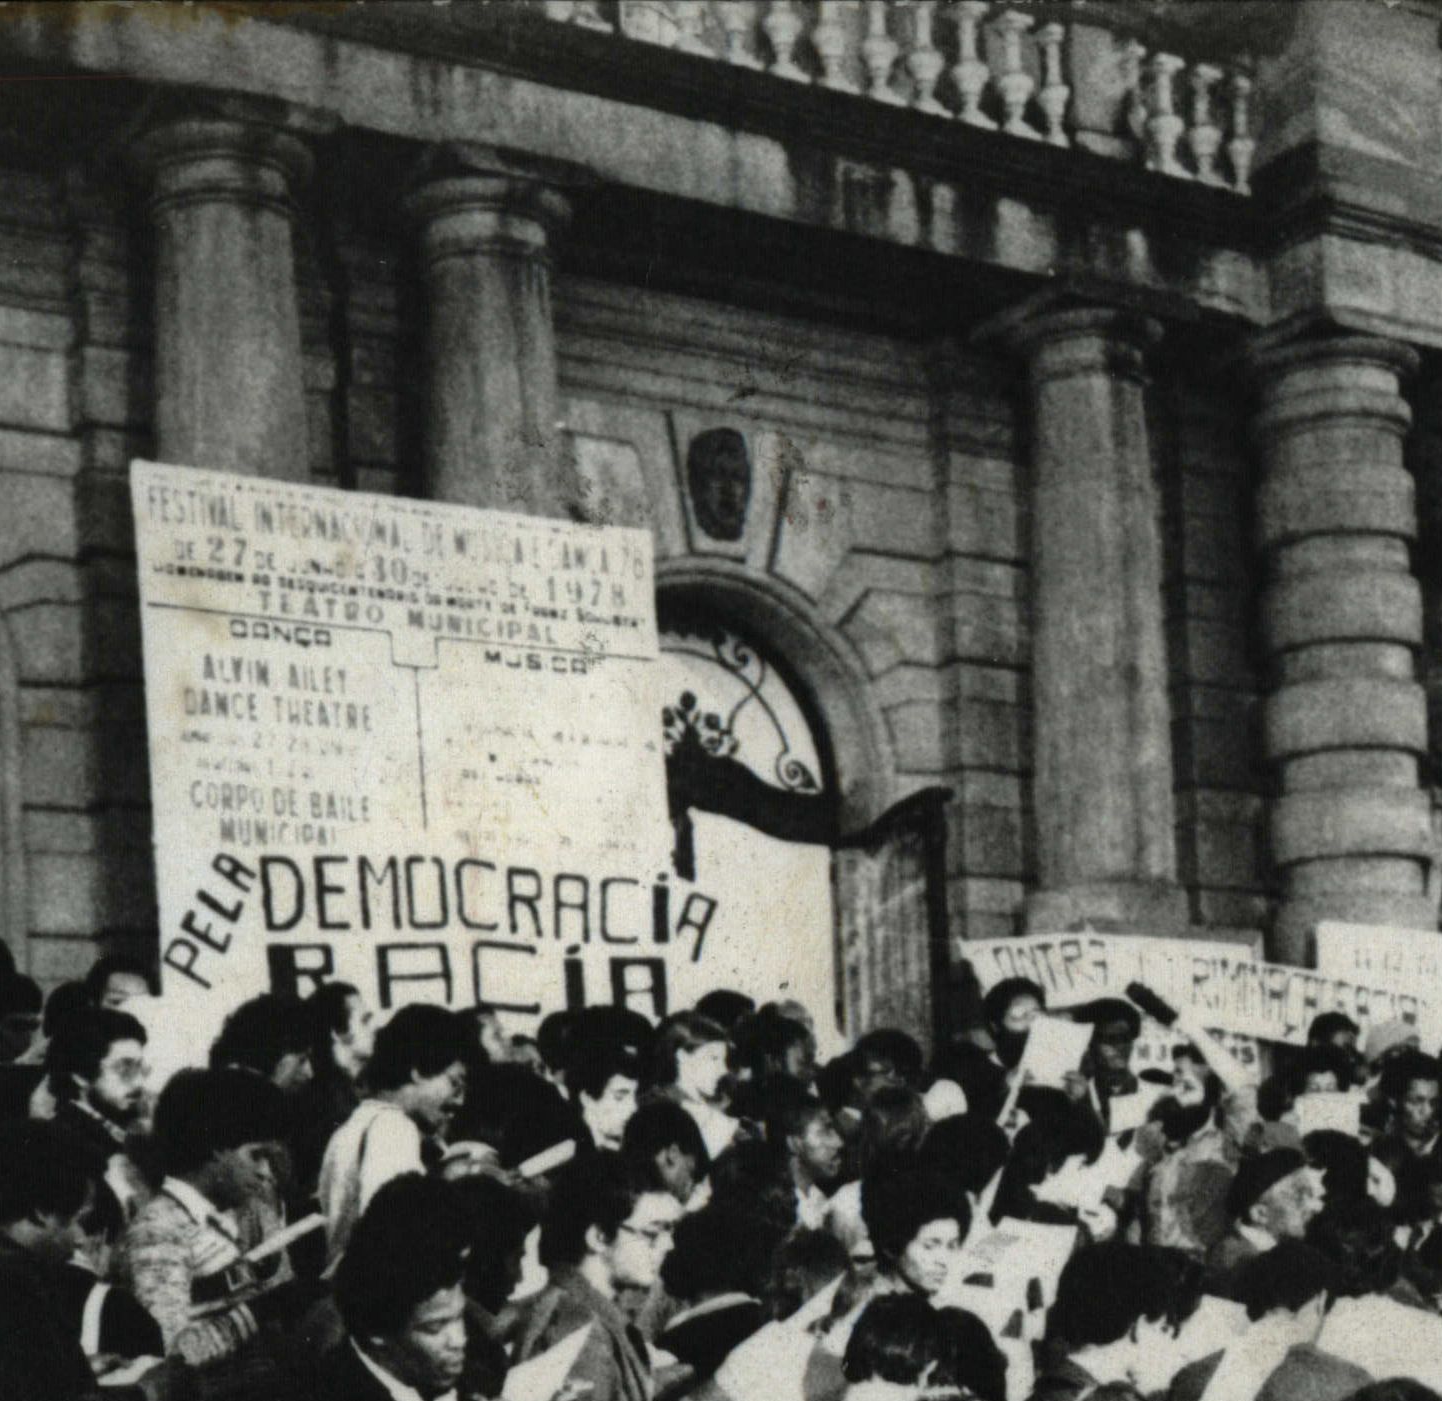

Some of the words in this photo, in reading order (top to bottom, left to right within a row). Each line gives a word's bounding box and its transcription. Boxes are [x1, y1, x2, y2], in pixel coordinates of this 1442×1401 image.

[207, 536, 247, 566] 27
[258, 591, 385, 623] TEATRO
[407, 609, 559, 645] MUNICIPAL
[183, 686, 258, 721] DANCE
[273, 695, 372, 731] THEATRE
[190, 780, 264, 813] CORPO
[273, 787, 298, 817] DE
[310, 791, 370, 822] BAILE
[163, 852, 257, 990] PELA
